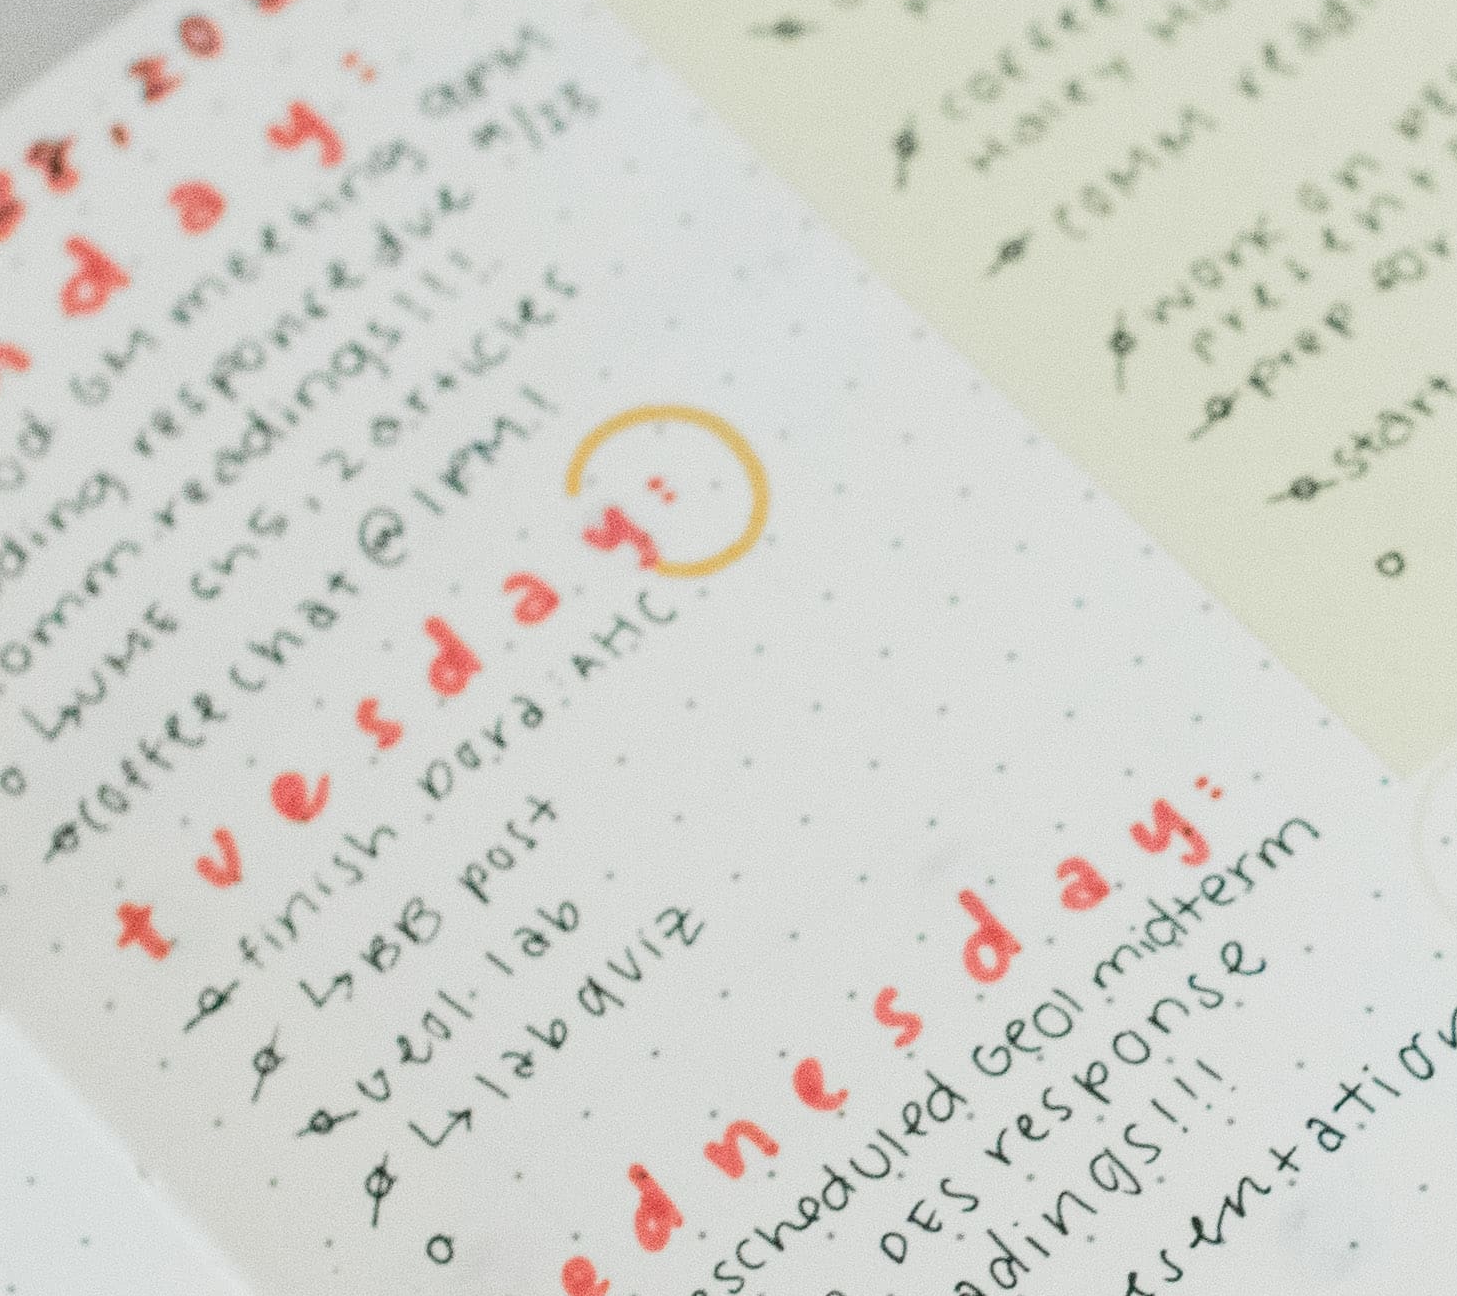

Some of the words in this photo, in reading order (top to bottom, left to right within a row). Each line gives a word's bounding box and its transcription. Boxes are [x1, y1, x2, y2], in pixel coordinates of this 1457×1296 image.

[1146, 214, 1281, 326] work
[1297, 153, 1379, 214] on
[1244, 301, 1355, 400] prep
[323, 451, 362, 481] 2
[1331, 374, 1457, 481] start
[357, 508, 406, 567] @
[238, 825, 397, 966] finish
[513, 900, 580, 959] lab
[1091, 817, 1321, 991] midterm
[474, 1017, 569, 1100] lab
[878, 1176, 981, 1266] DES
[983, 939, 1268, 1167] response
